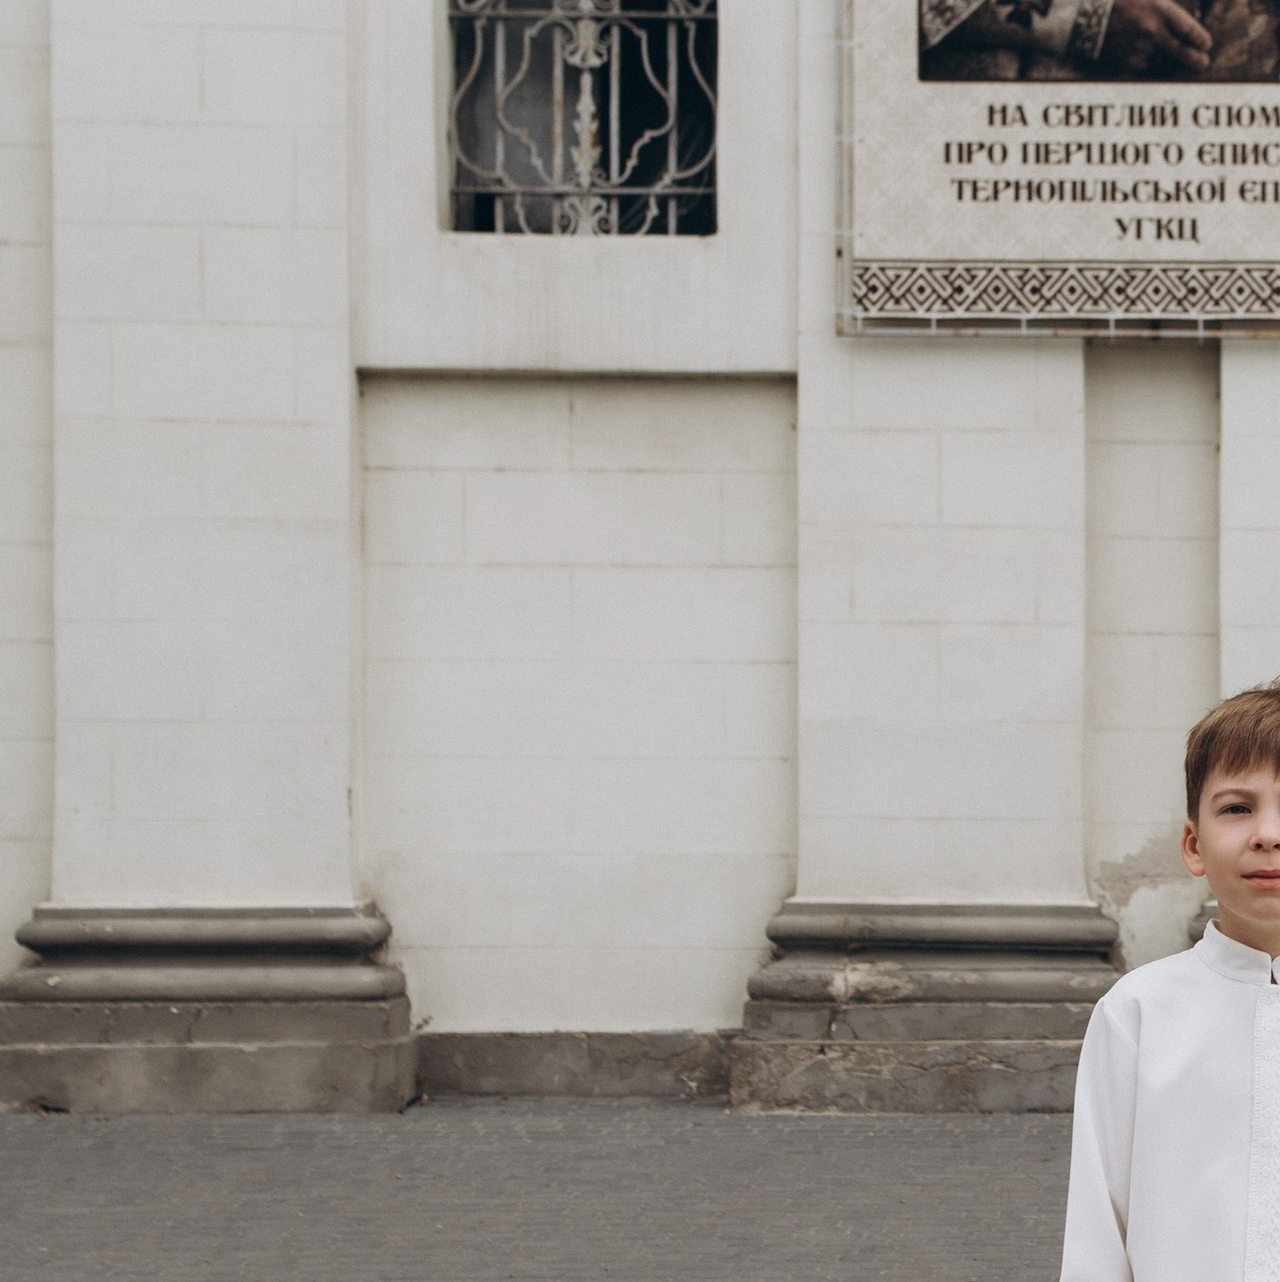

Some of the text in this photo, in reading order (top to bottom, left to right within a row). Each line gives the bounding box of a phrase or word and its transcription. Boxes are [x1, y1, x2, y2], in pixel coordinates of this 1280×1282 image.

[985, 102, 1031, 129] НА
[1041, 100, 1181, 130] СВІТЛИЙ
[941, 139, 1010, 167] ПРО
[1020, 139, 1185, 168] ПЕРШОГО
[949, 174, 1227, 206] ТЕРНОПІЛЬСЬКОЇ
[1113, 216, 1202, 245] УГКЦ
